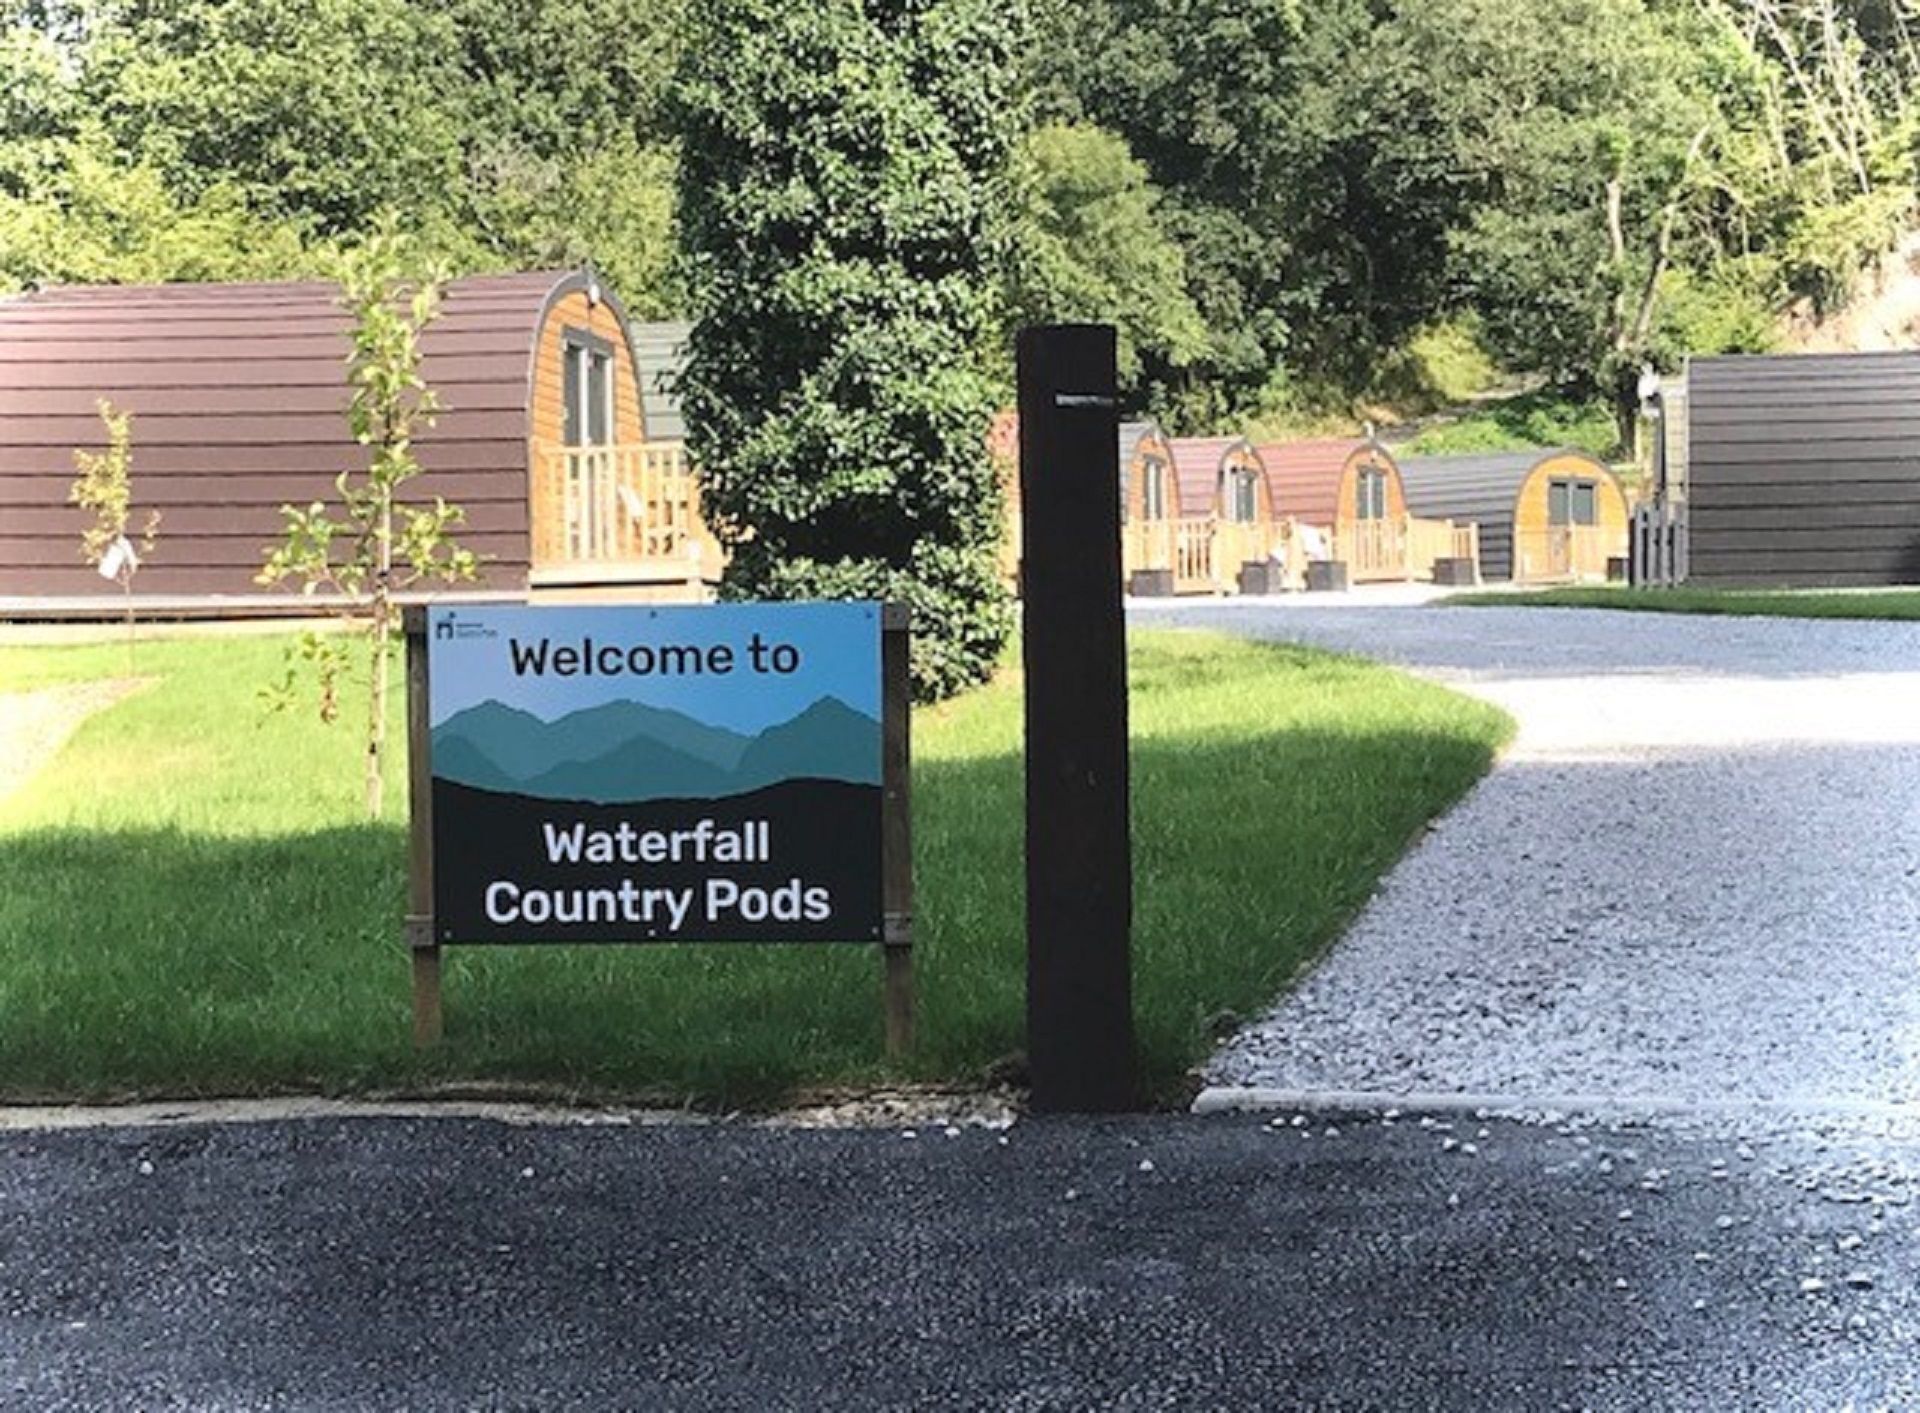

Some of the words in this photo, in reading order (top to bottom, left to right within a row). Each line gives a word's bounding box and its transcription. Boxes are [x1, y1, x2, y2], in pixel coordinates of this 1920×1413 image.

[509, 637, 734, 677] Welcome
[746, 632, 800, 676] to
[543, 819, 769, 863] Waterfall
[486, 879, 693, 932] Country
[706, 878, 831, 922] Pods
